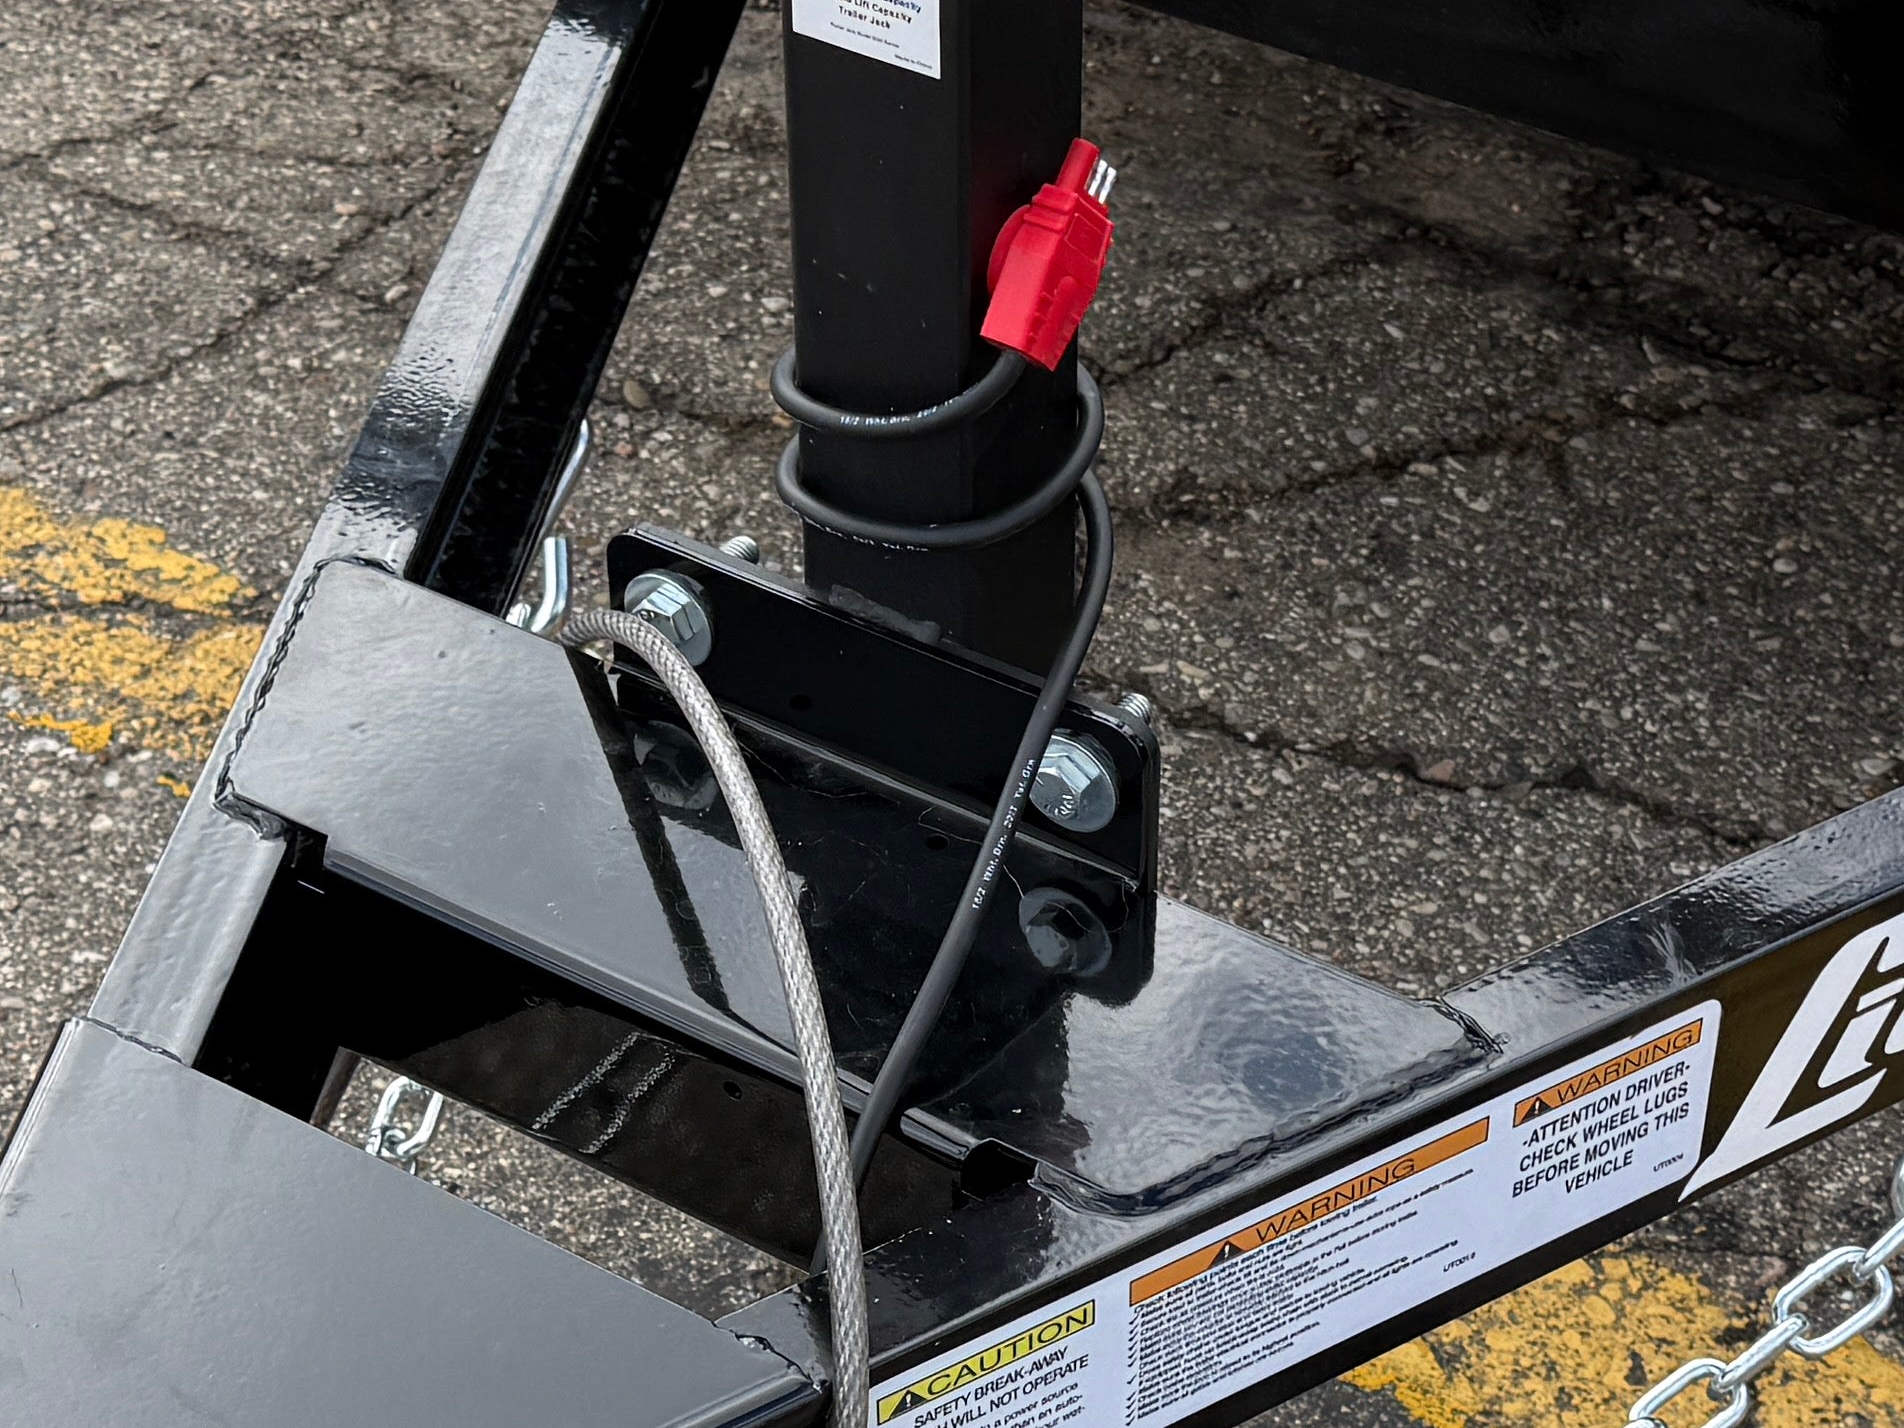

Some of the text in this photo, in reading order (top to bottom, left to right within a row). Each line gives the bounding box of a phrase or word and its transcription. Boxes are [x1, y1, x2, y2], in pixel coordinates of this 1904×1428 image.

[1523, 1058, 1689, 1149] -ATTENTION DRIVER-
[1557, 1028, 1692, 1104] WARNING
[1512, 1101, 1688, 1198] BEFORE MOVING THIS
[1519, 1080, 1687, 1172] CHECK WHEEL LUGS
[1256, 1158, 1417, 1242] WARNING
[1565, 1149, 1633, 1194] VEHICLE
[927, 1308, 1088, 1396] CAUTION
[975, 1345, 1067, 1401] BREAK-AWAY
[990, 1387, 1018, 1412] NOT
[1023, 1353, 1088, 1396] OPERATE
[994, 1418, 1001, 1428] a
[1004, 1401, 1037, 1426] power
[1041, 1381, 1078, 1407] source
[1038, 1408, 1051, 1421] an
[1055, 1392, 1083, 1413] auto-
